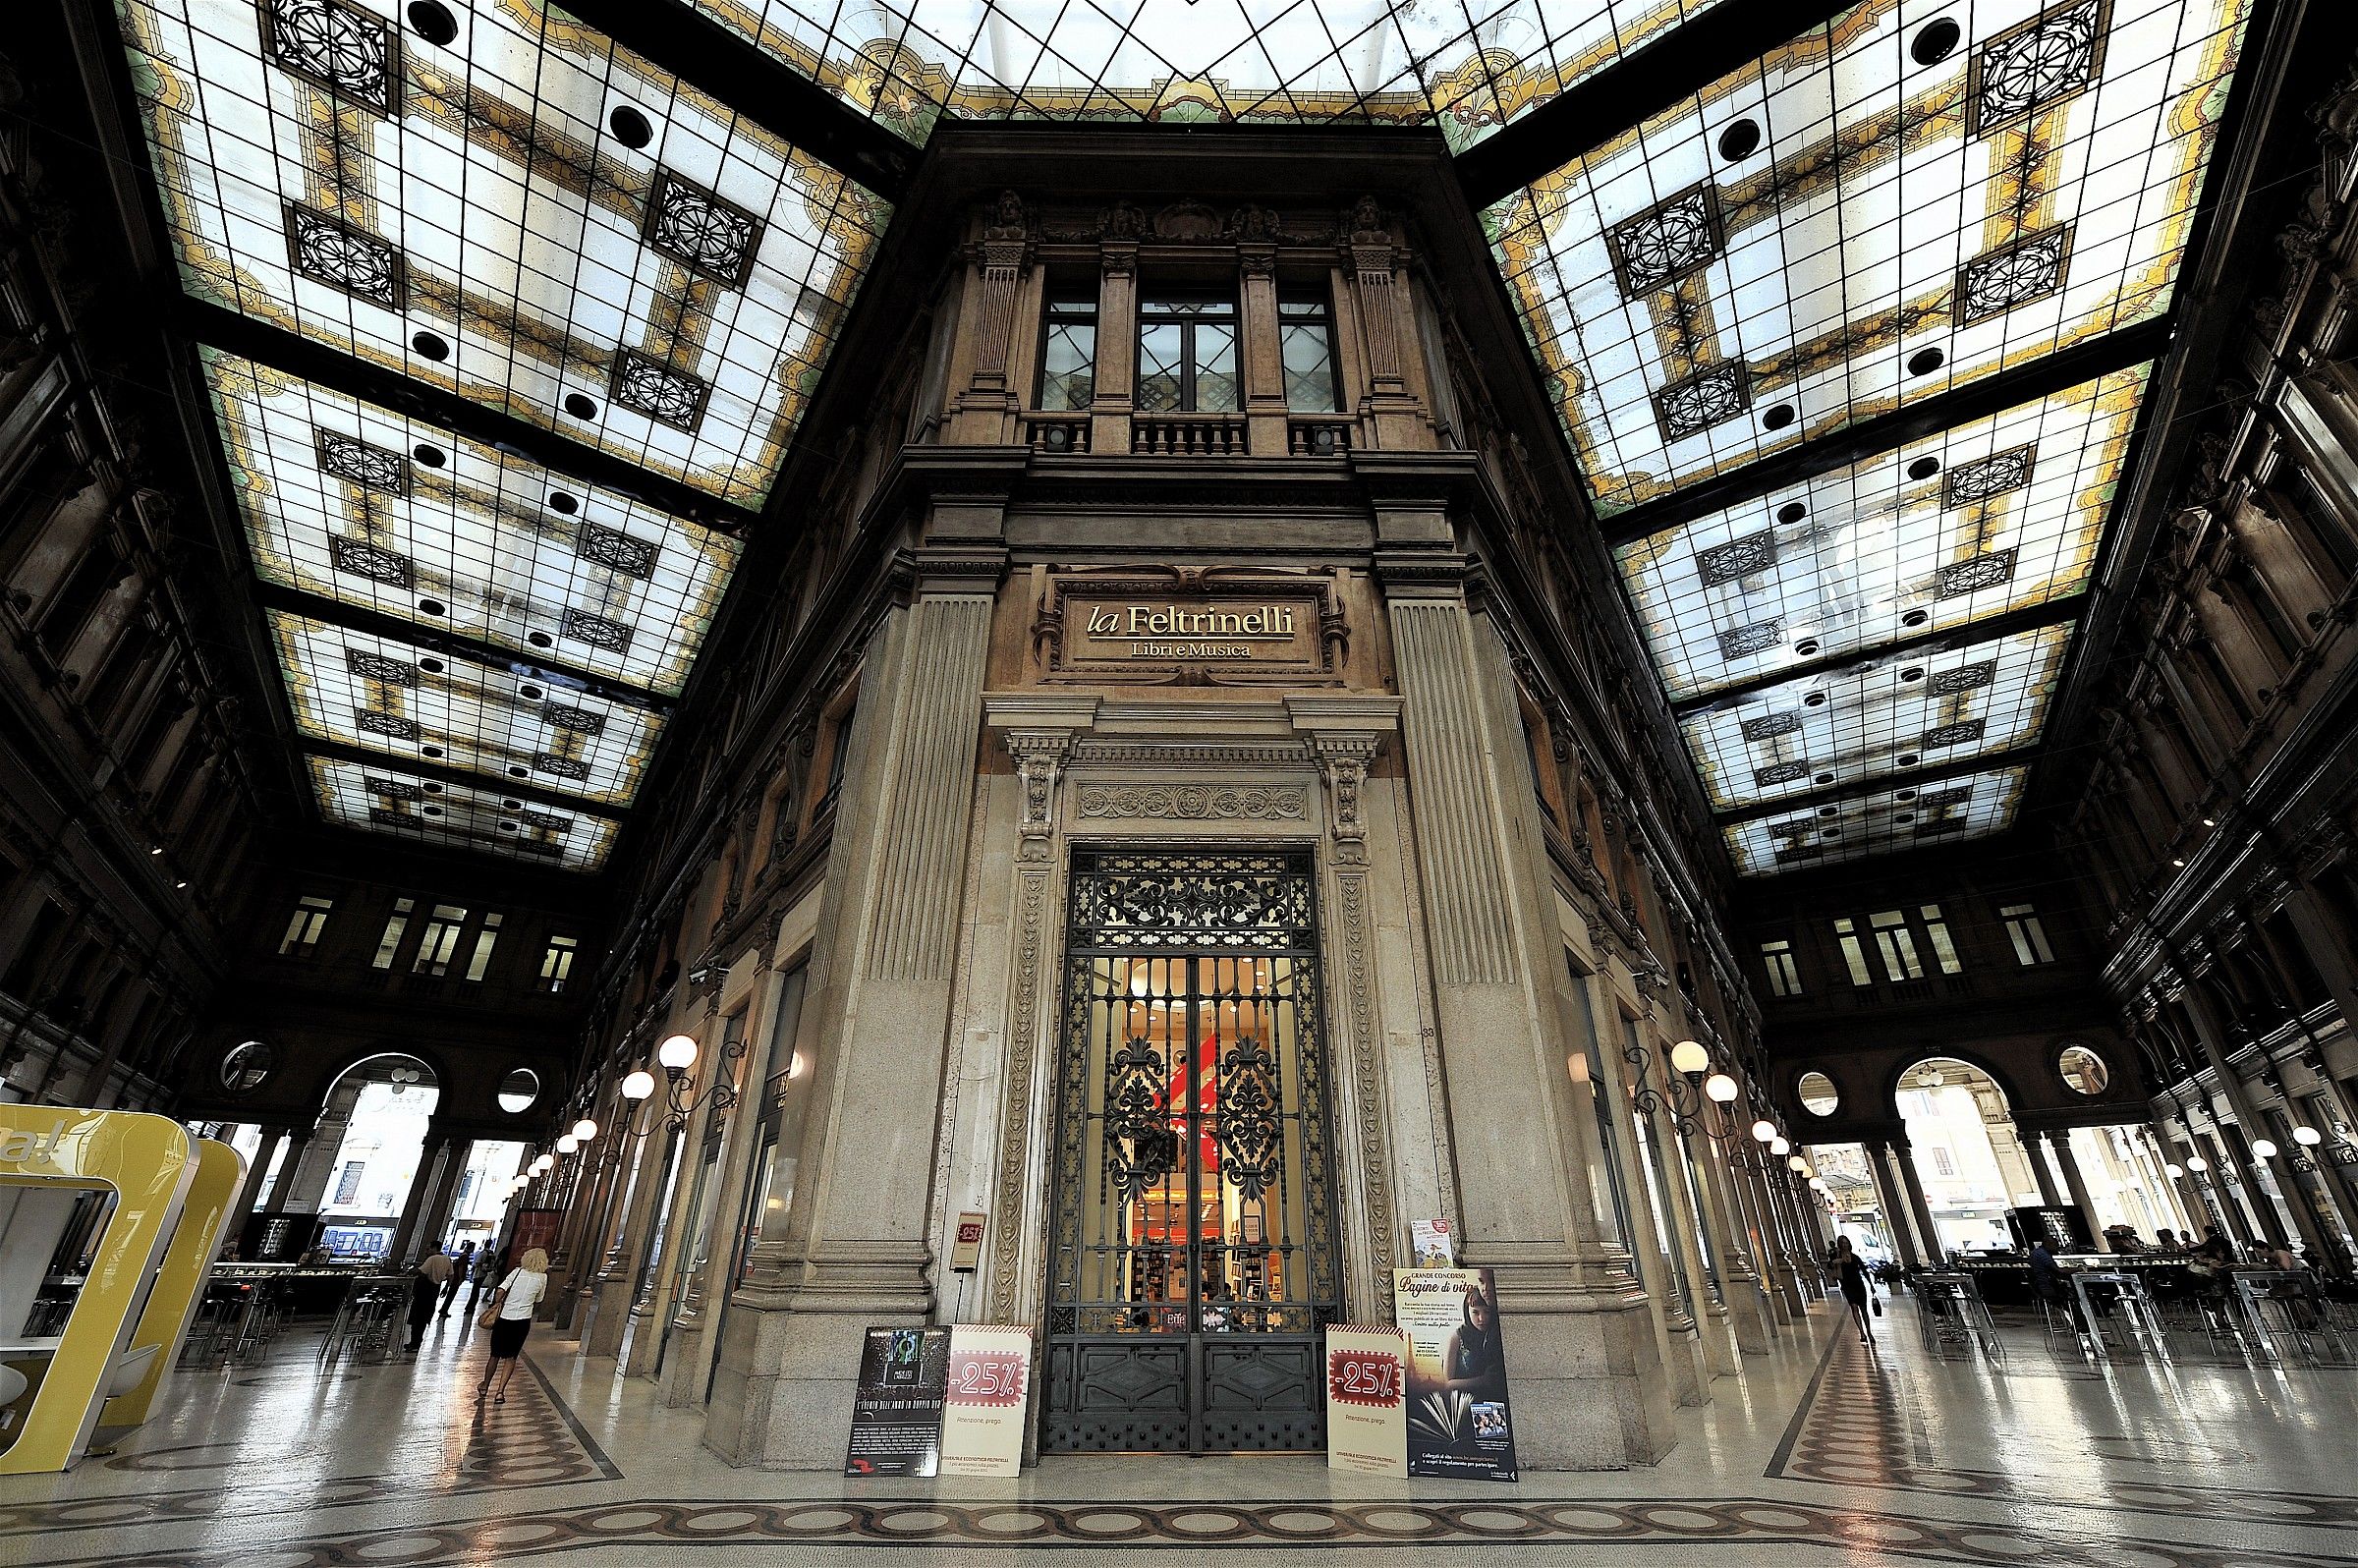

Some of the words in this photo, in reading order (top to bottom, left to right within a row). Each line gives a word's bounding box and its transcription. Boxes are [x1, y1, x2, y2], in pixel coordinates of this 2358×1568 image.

[1087, 605, 1120, 633] la
[1126, 605, 1296, 634] Feltrinelli
[1132, 643, 1173, 656] Libri
[1176, 645, 1187, 656] e
[1188, 643, 1252, 657] Musica
[0, 1118, 67, 1164] a!
[959, 1226, 981, 1241] -25%
[1398, 1276, 1439, 1298] Pagine
[1440, 1280, 1451, 1293] di
[1452, 1280, 1475, 1293] vita
[950, 1361, 1017, 1397] -25%
[1334, 1361, 1393, 1397] -25%
